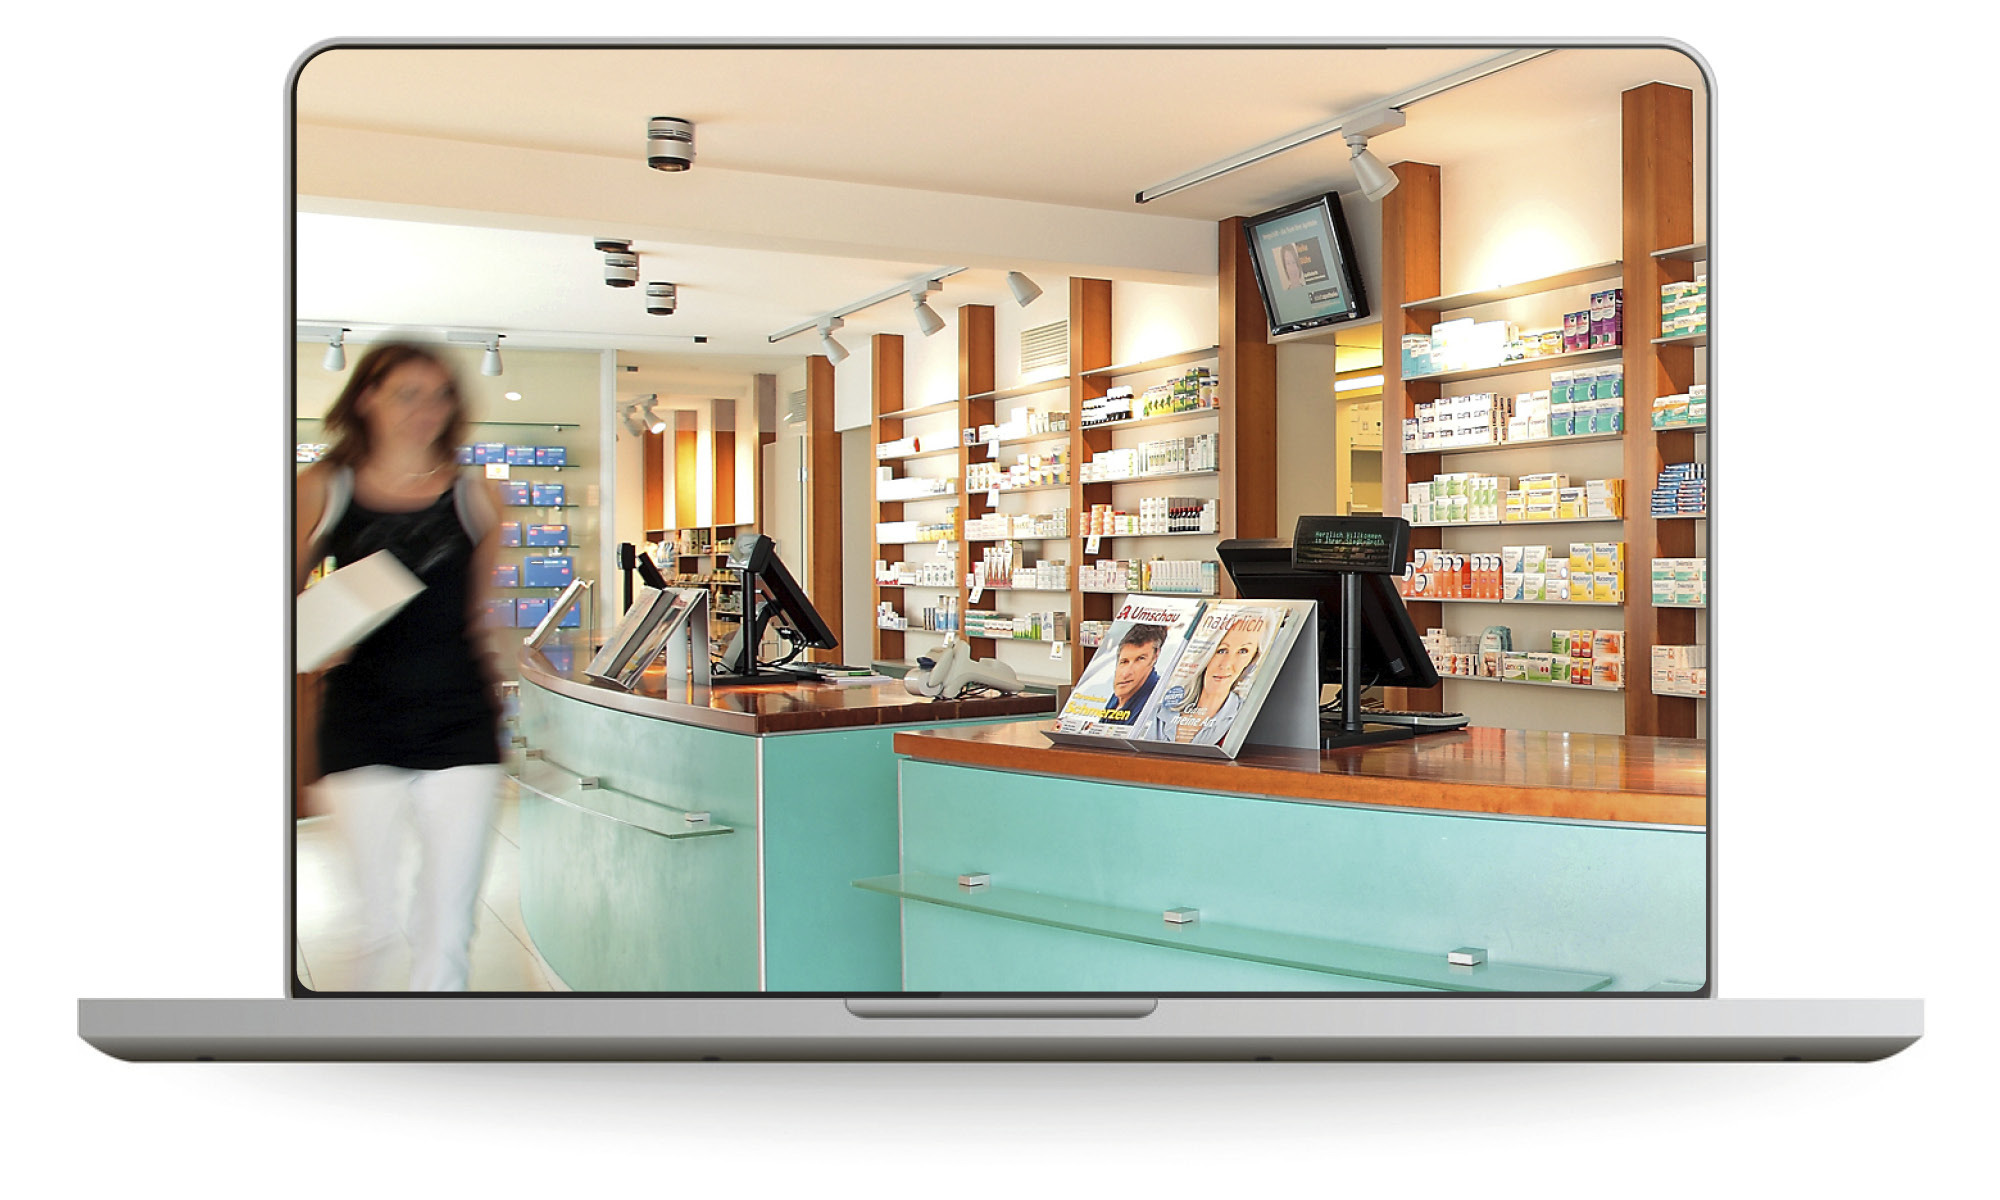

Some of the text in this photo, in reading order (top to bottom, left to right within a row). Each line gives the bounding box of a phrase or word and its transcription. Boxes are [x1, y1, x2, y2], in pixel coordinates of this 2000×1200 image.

[1131, 606, 1181, 623] Umschau
[1203, 613, 1264, 632] natürlich
[1065, 702, 1131, 721] Schmerzen
[1170, 714, 1201, 727] meine
